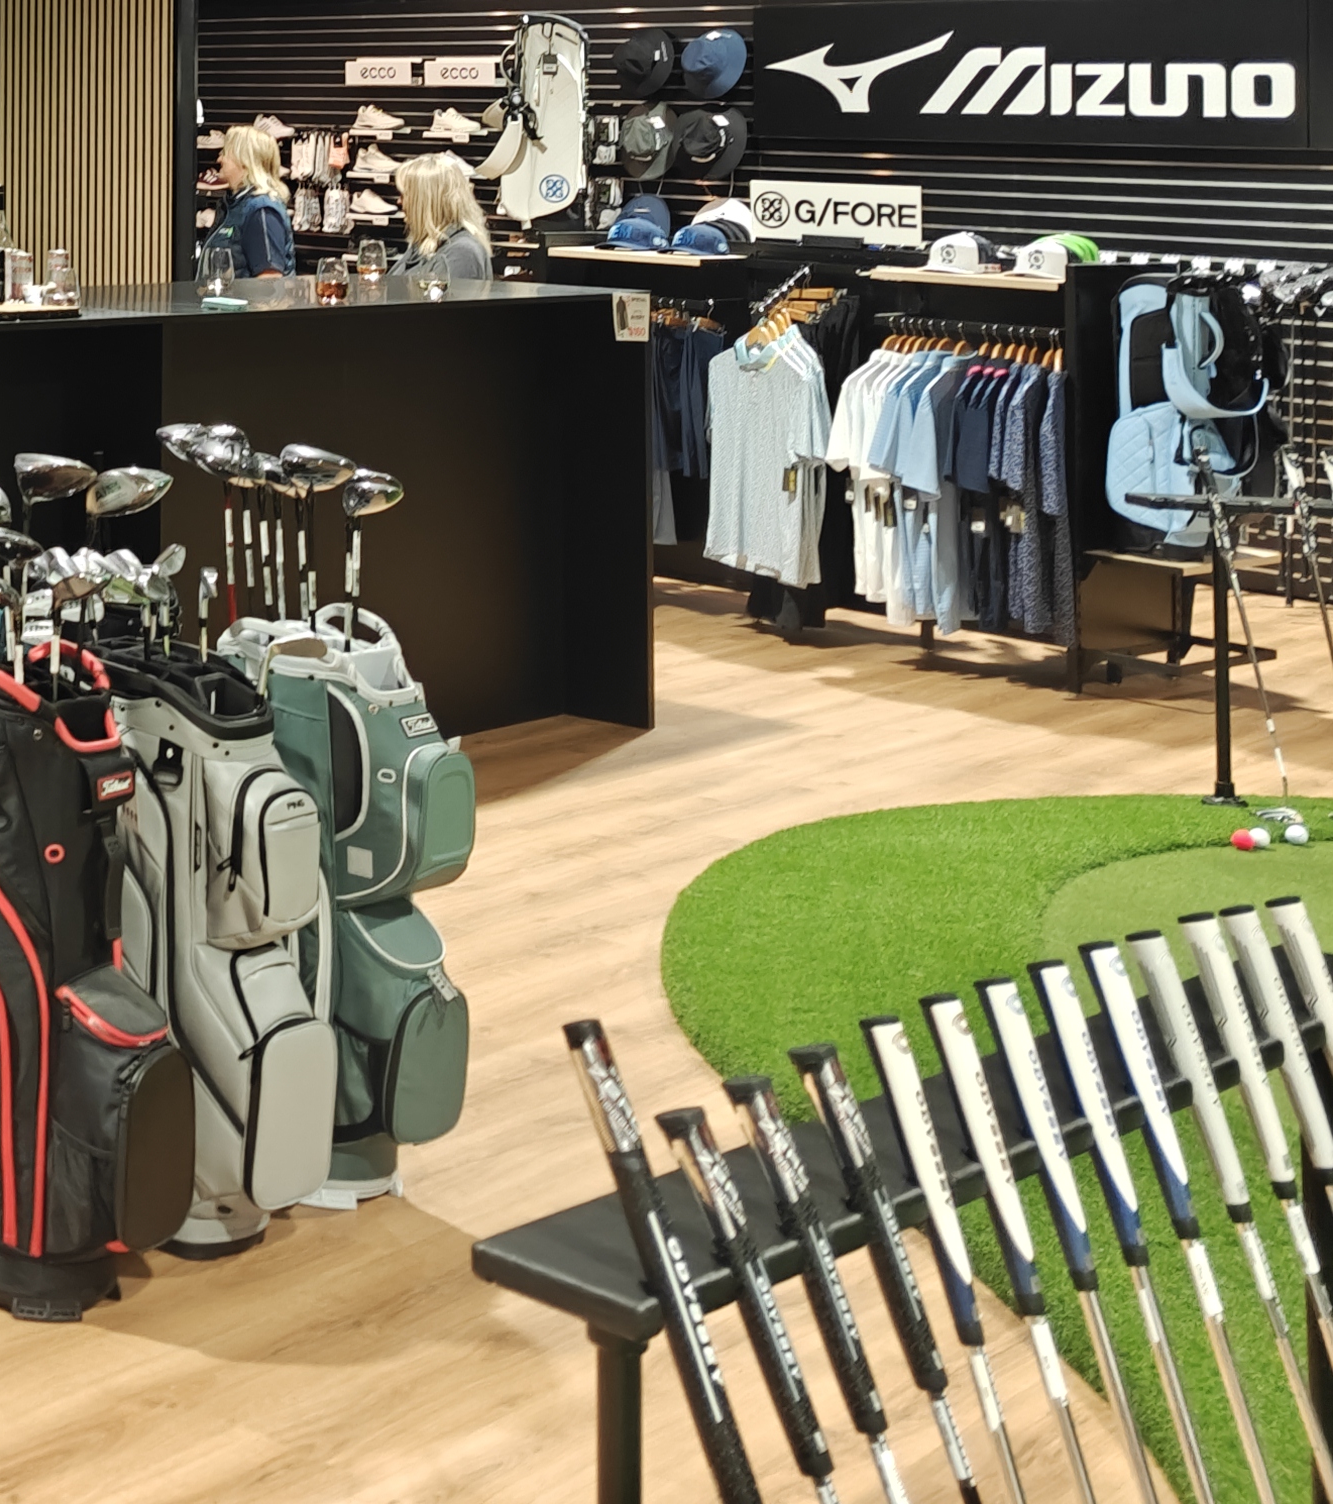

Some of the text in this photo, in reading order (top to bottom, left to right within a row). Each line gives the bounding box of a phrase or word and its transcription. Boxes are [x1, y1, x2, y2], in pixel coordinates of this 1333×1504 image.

[360, 66, 396, 80] ecco
[440, 66, 479, 80] ecco
[794, 198, 918, 228] G/FORE
[286, 799, 306, 810] PING
